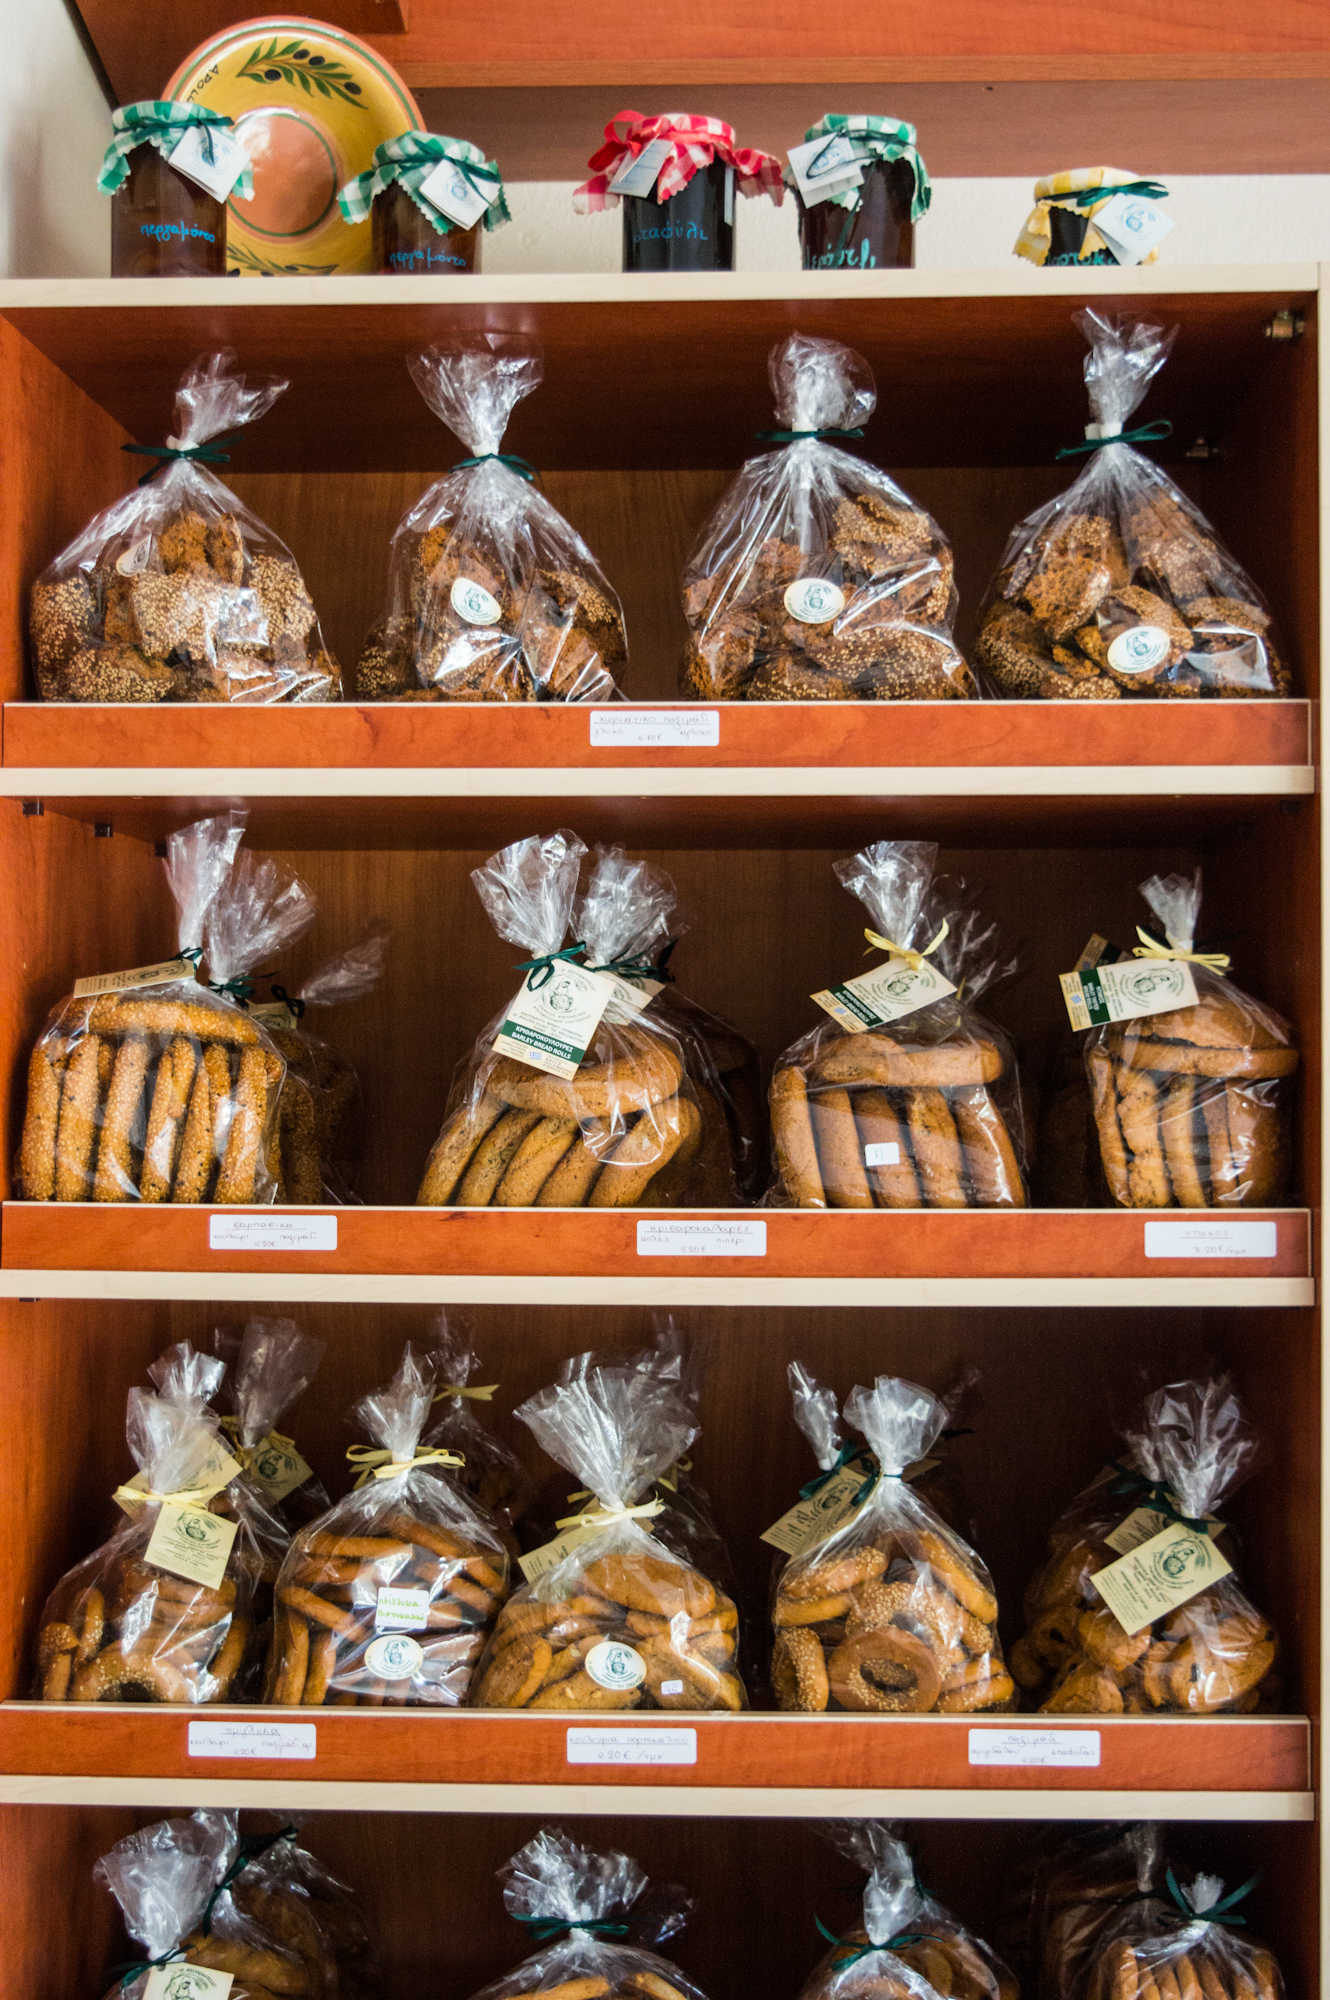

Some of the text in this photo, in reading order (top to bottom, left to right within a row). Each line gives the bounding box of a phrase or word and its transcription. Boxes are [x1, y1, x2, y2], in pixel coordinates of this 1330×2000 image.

[633, 221, 708, 243] σταφύλι
[511, 1031, 534, 1045] BARLEY
[533, 1040, 553, 1053] BREAD
[553, 1048, 572, 1060] ROLLS
